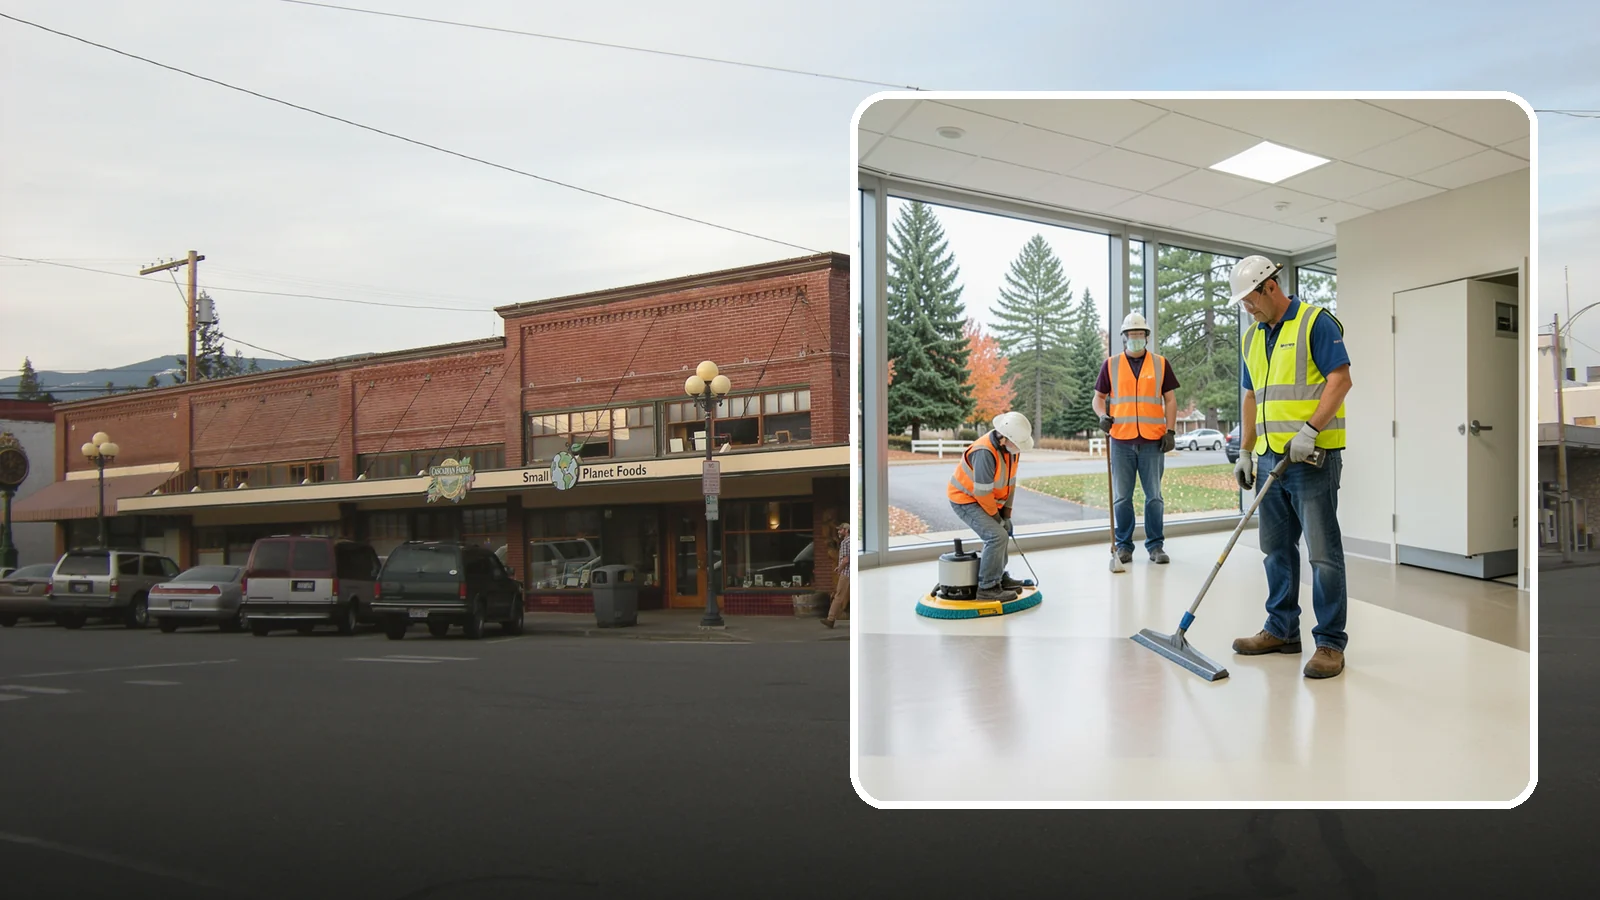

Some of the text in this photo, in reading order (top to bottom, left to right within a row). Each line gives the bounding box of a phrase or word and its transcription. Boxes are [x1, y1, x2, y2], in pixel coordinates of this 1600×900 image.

[523, 464, 647, 483] Small Planet Foods
